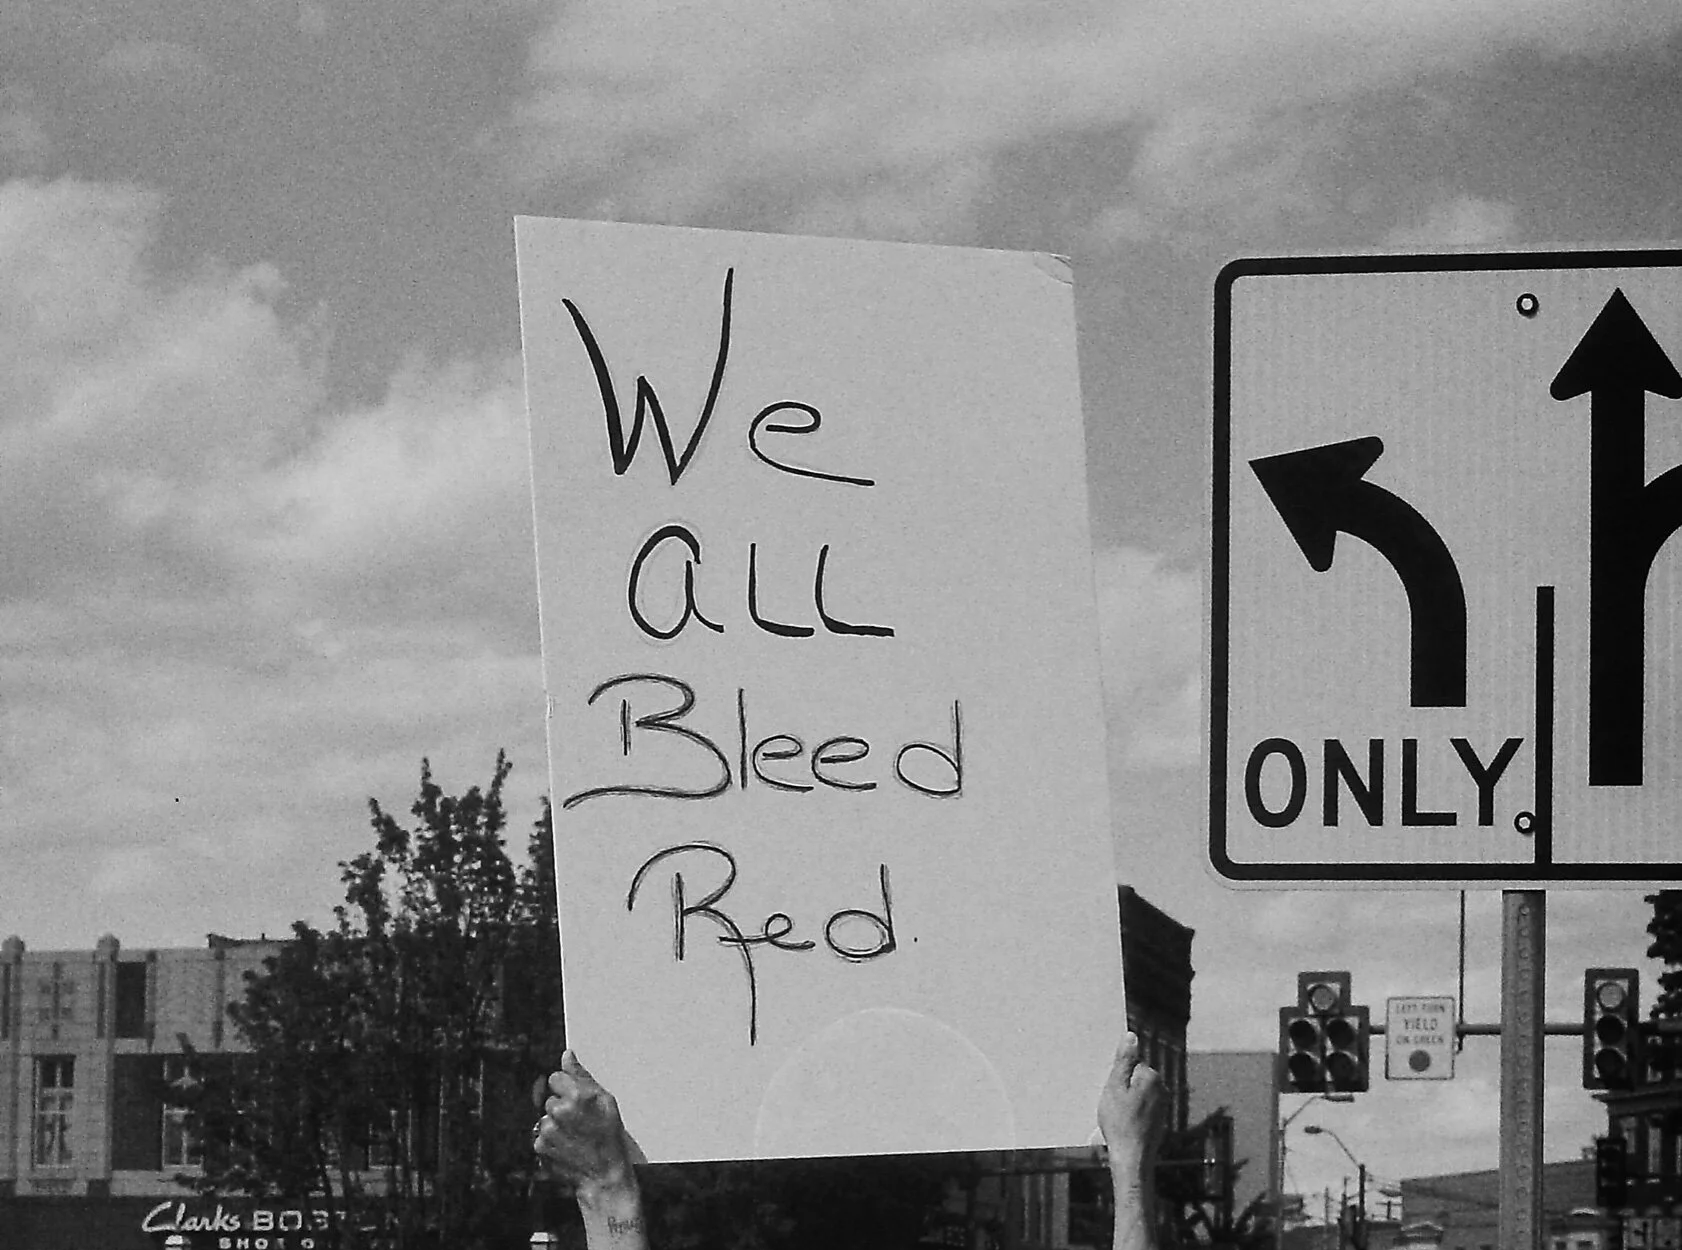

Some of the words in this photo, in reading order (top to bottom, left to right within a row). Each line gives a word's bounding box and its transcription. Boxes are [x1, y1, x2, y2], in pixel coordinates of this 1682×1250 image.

[562, 267, 875, 487] We
[562, 672, 963, 810] Bleed
[1244, 737, 1525, 829] ONLY
[1403, 1017, 1438, 1031] YIELD
[141, 1200, 241, 1232] Clarks
